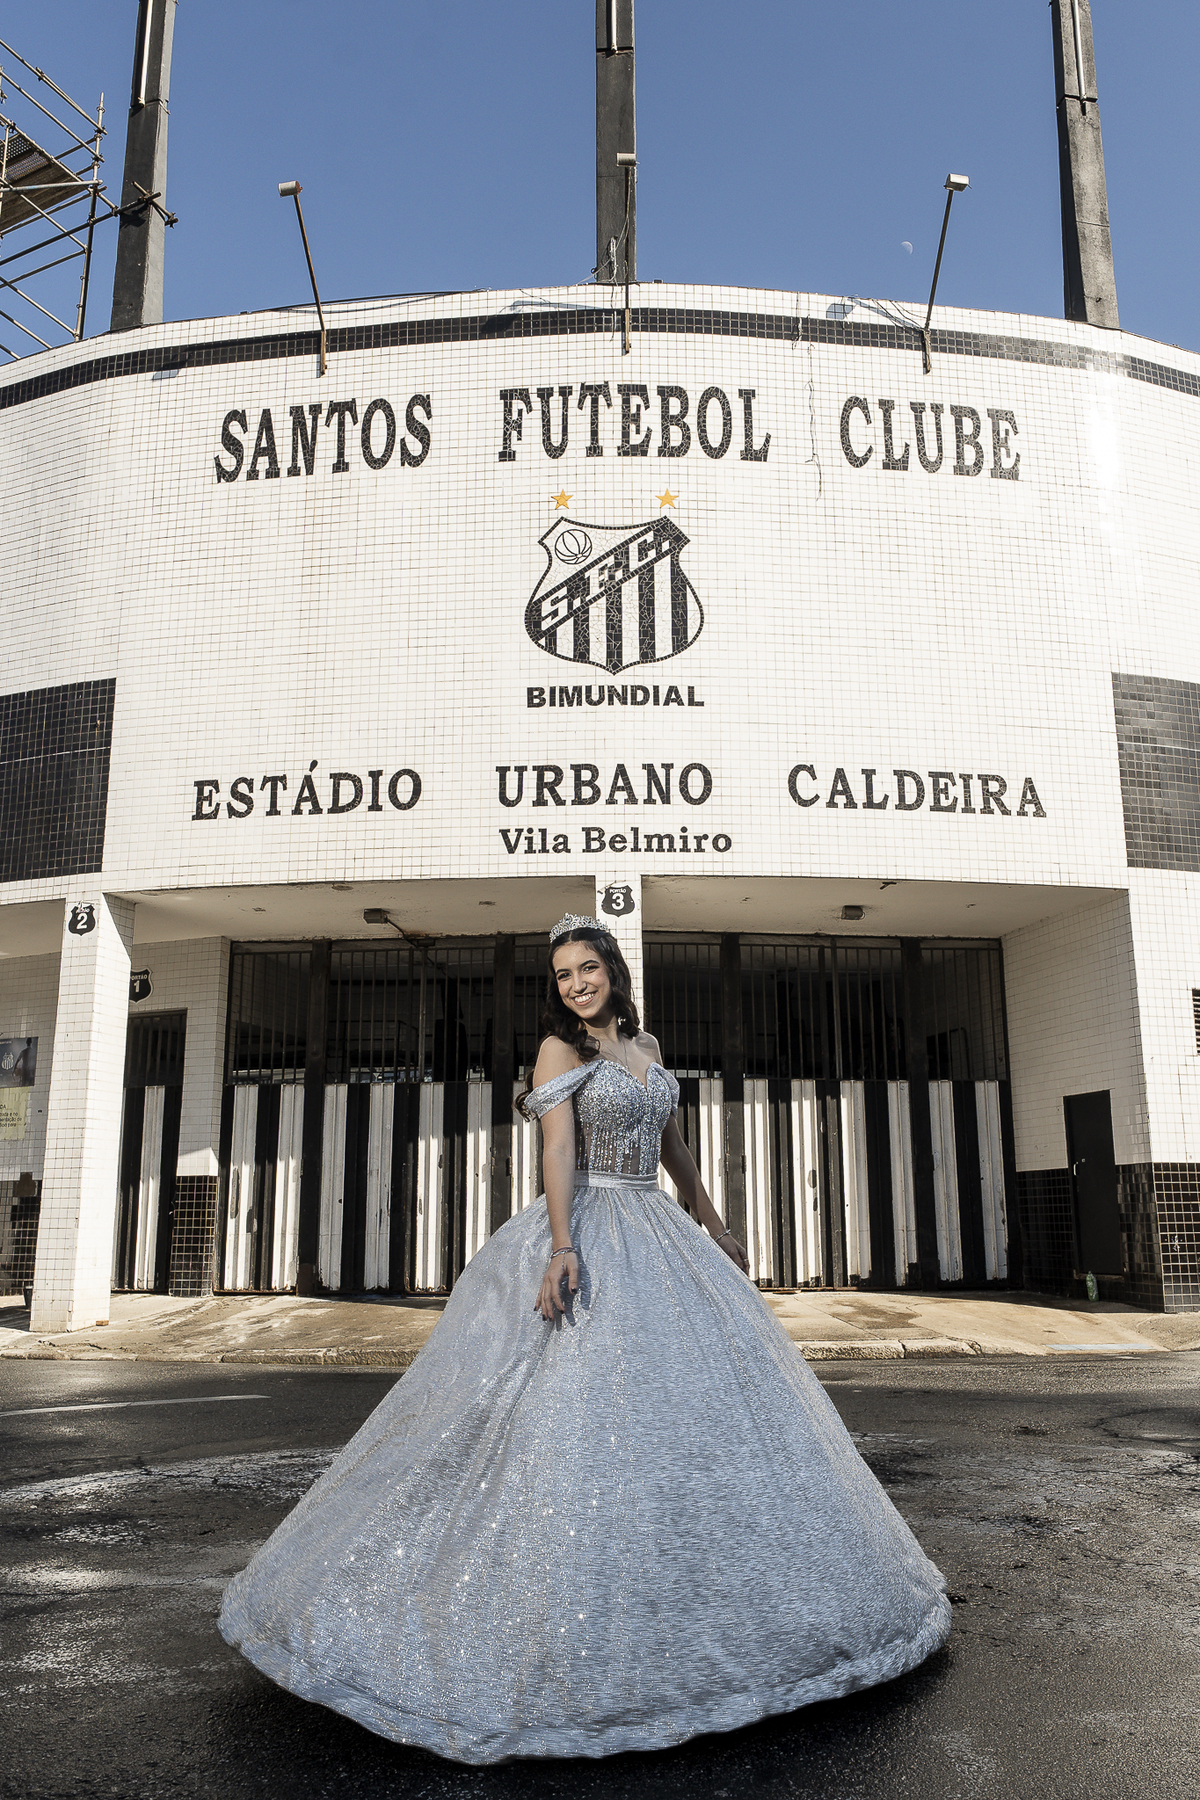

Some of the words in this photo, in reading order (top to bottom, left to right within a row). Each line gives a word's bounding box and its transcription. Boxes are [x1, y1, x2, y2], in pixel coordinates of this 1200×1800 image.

[214, 394, 432, 484] SANTOS
[499, 381, 771, 463] FUTEBOL
[840, 396, 1019, 481] CLUBE
[527, 685, 704, 708] BIMUNDIAL
[192, 760, 421, 821] ESTÁDIO
[496, 763, 712, 807] URBANO
[788, 765, 1046, 817] CALDEIRA
[499, 828, 571, 854] Vila
[582, 827, 731, 854] Belmiro
[611, 893, 625, 911] 3
[76, 912, 88, 930] 2
[133, 980, 140, 993] 1
